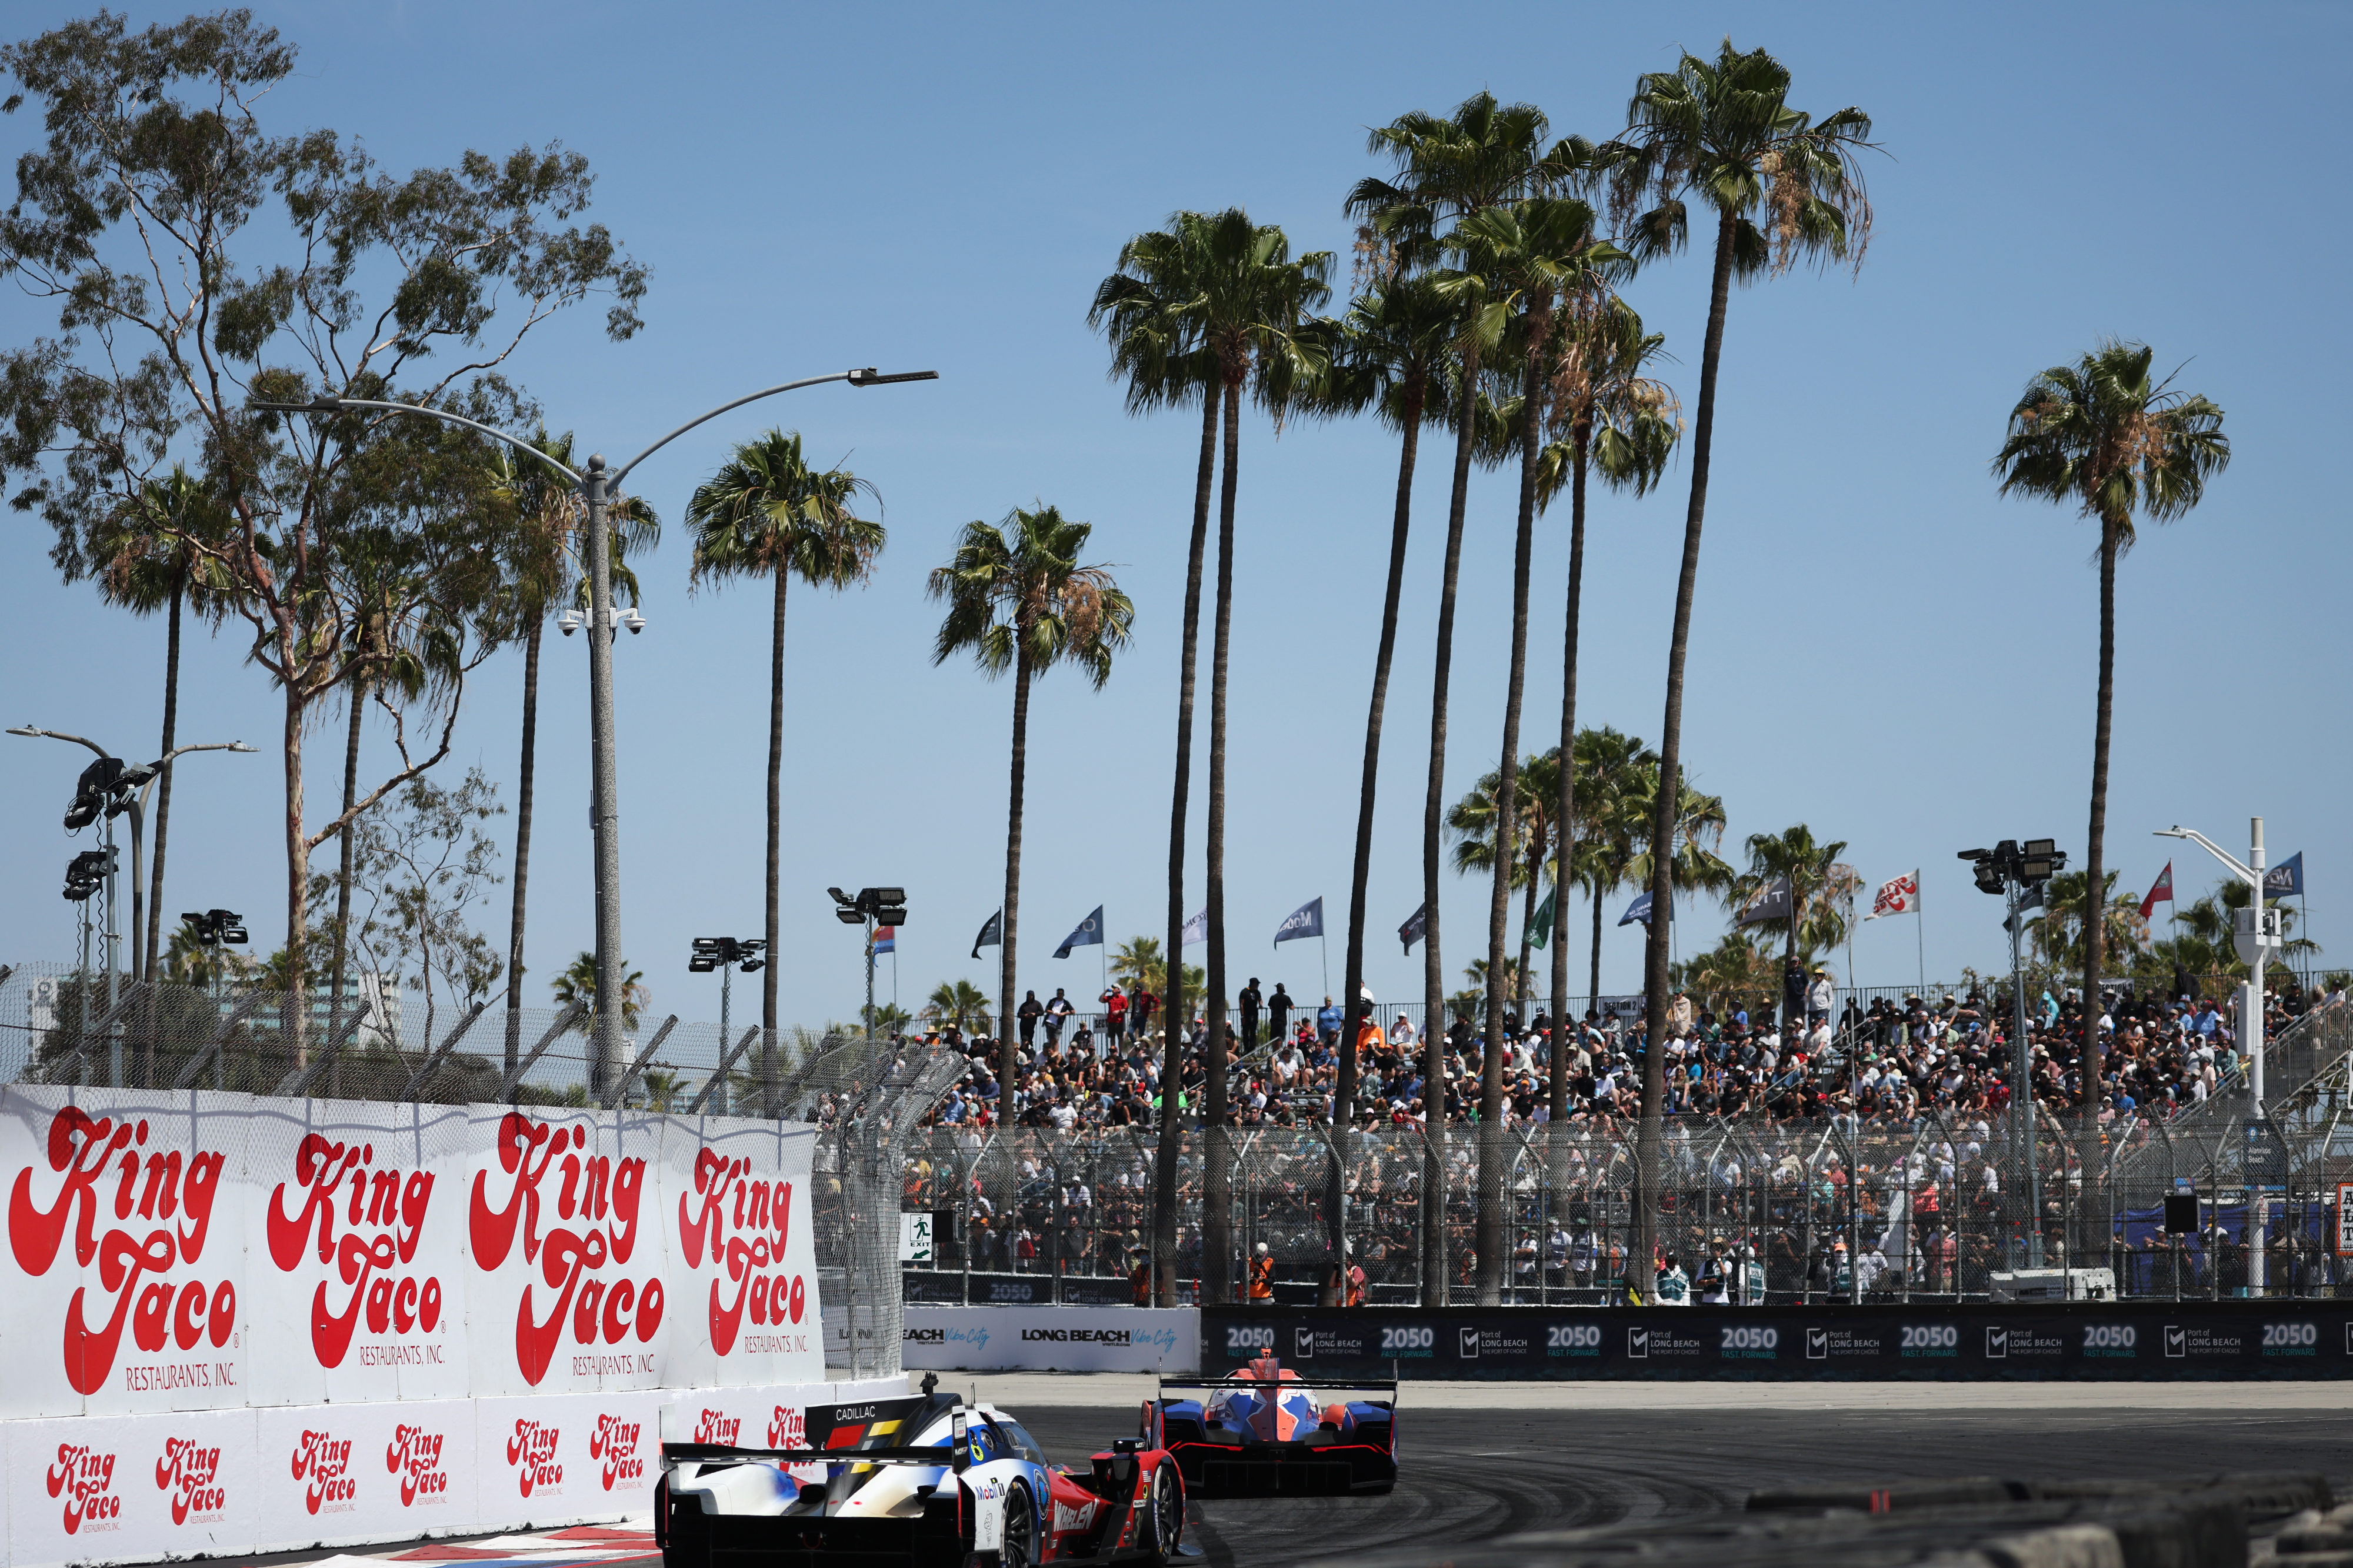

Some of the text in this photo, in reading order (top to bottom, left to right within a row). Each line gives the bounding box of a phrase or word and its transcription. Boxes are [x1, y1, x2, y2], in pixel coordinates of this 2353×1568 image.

[1604, 1001, 1637, 1011] SECTION 2
[8, 1106, 225, 1276] King
[267, 1133, 435, 1272] King
[469, 1112, 646, 1272] King
[679, 1147, 792, 1269] King
[64, 1229, 235, 1395] Taco
[312, 1233, 441, 1369] Taco
[516, 1229, 664, 1386] Taco
[709, 1237, 804, 1356] Taco
[745, 1335, 809, 1354] RESTAURANTS, INC.
[945, 1327, 966, 1342] Vibe
[966, 1327, 990, 1351] City
[1021, 1328, 1177, 1353] LONG BEACH Vibe City
[1227, 1327, 1275, 1347] 2050
[1329, 1331, 1335, 1339] of
[1381, 1327, 1434, 1348] 2050
[1495, 1330, 1501, 1339] of
[1548, 1326, 1601, 1346] 2050
[1663, 1331, 1671, 1339] of
[1722, 1328, 1777, 1348] 2050
[1844, 1331, 1851, 1339] of
[1901, 1326, 1957, 1347] 2050
[2026, 1329, 2032, 1337] of
[2084, 1326, 2135, 1346] 2050
[2203, 1329, 2210, 1337] of
[2262, 1324, 2317, 1345] 2050
[359, 1345, 445, 1368] RESTAURANTS, INC.
[572, 1354, 655, 1376] RESTAURANTS, INC.
[126, 1362, 236, 1391] RESTAURANTS, INC.
[768, 1405, 806, 1450] Kin
[836, 1405, 875, 1421] CADILLAC
[386, 1424, 444, 1473] King
[507, 1419, 559, 1466] King
[590, 1413, 640, 1460] King
[46, 1443, 116, 1498] King
[155, 1437, 221, 1490] King
[292, 1430, 352, 1480] King
[602, 1445, 643, 1491] Taco
[306, 1464, 355, 1515] Taco
[401, 1458, 446, 1507] Taco
[520, 1450, 562, 1498] Taco
[64, 1480, 120, 1535] Taco
[172, 1473, 224, 1526] Taco
[975, 1483, 998, 1501] Mobil
[1054, 1498, 1099, 1532] WHELEN
